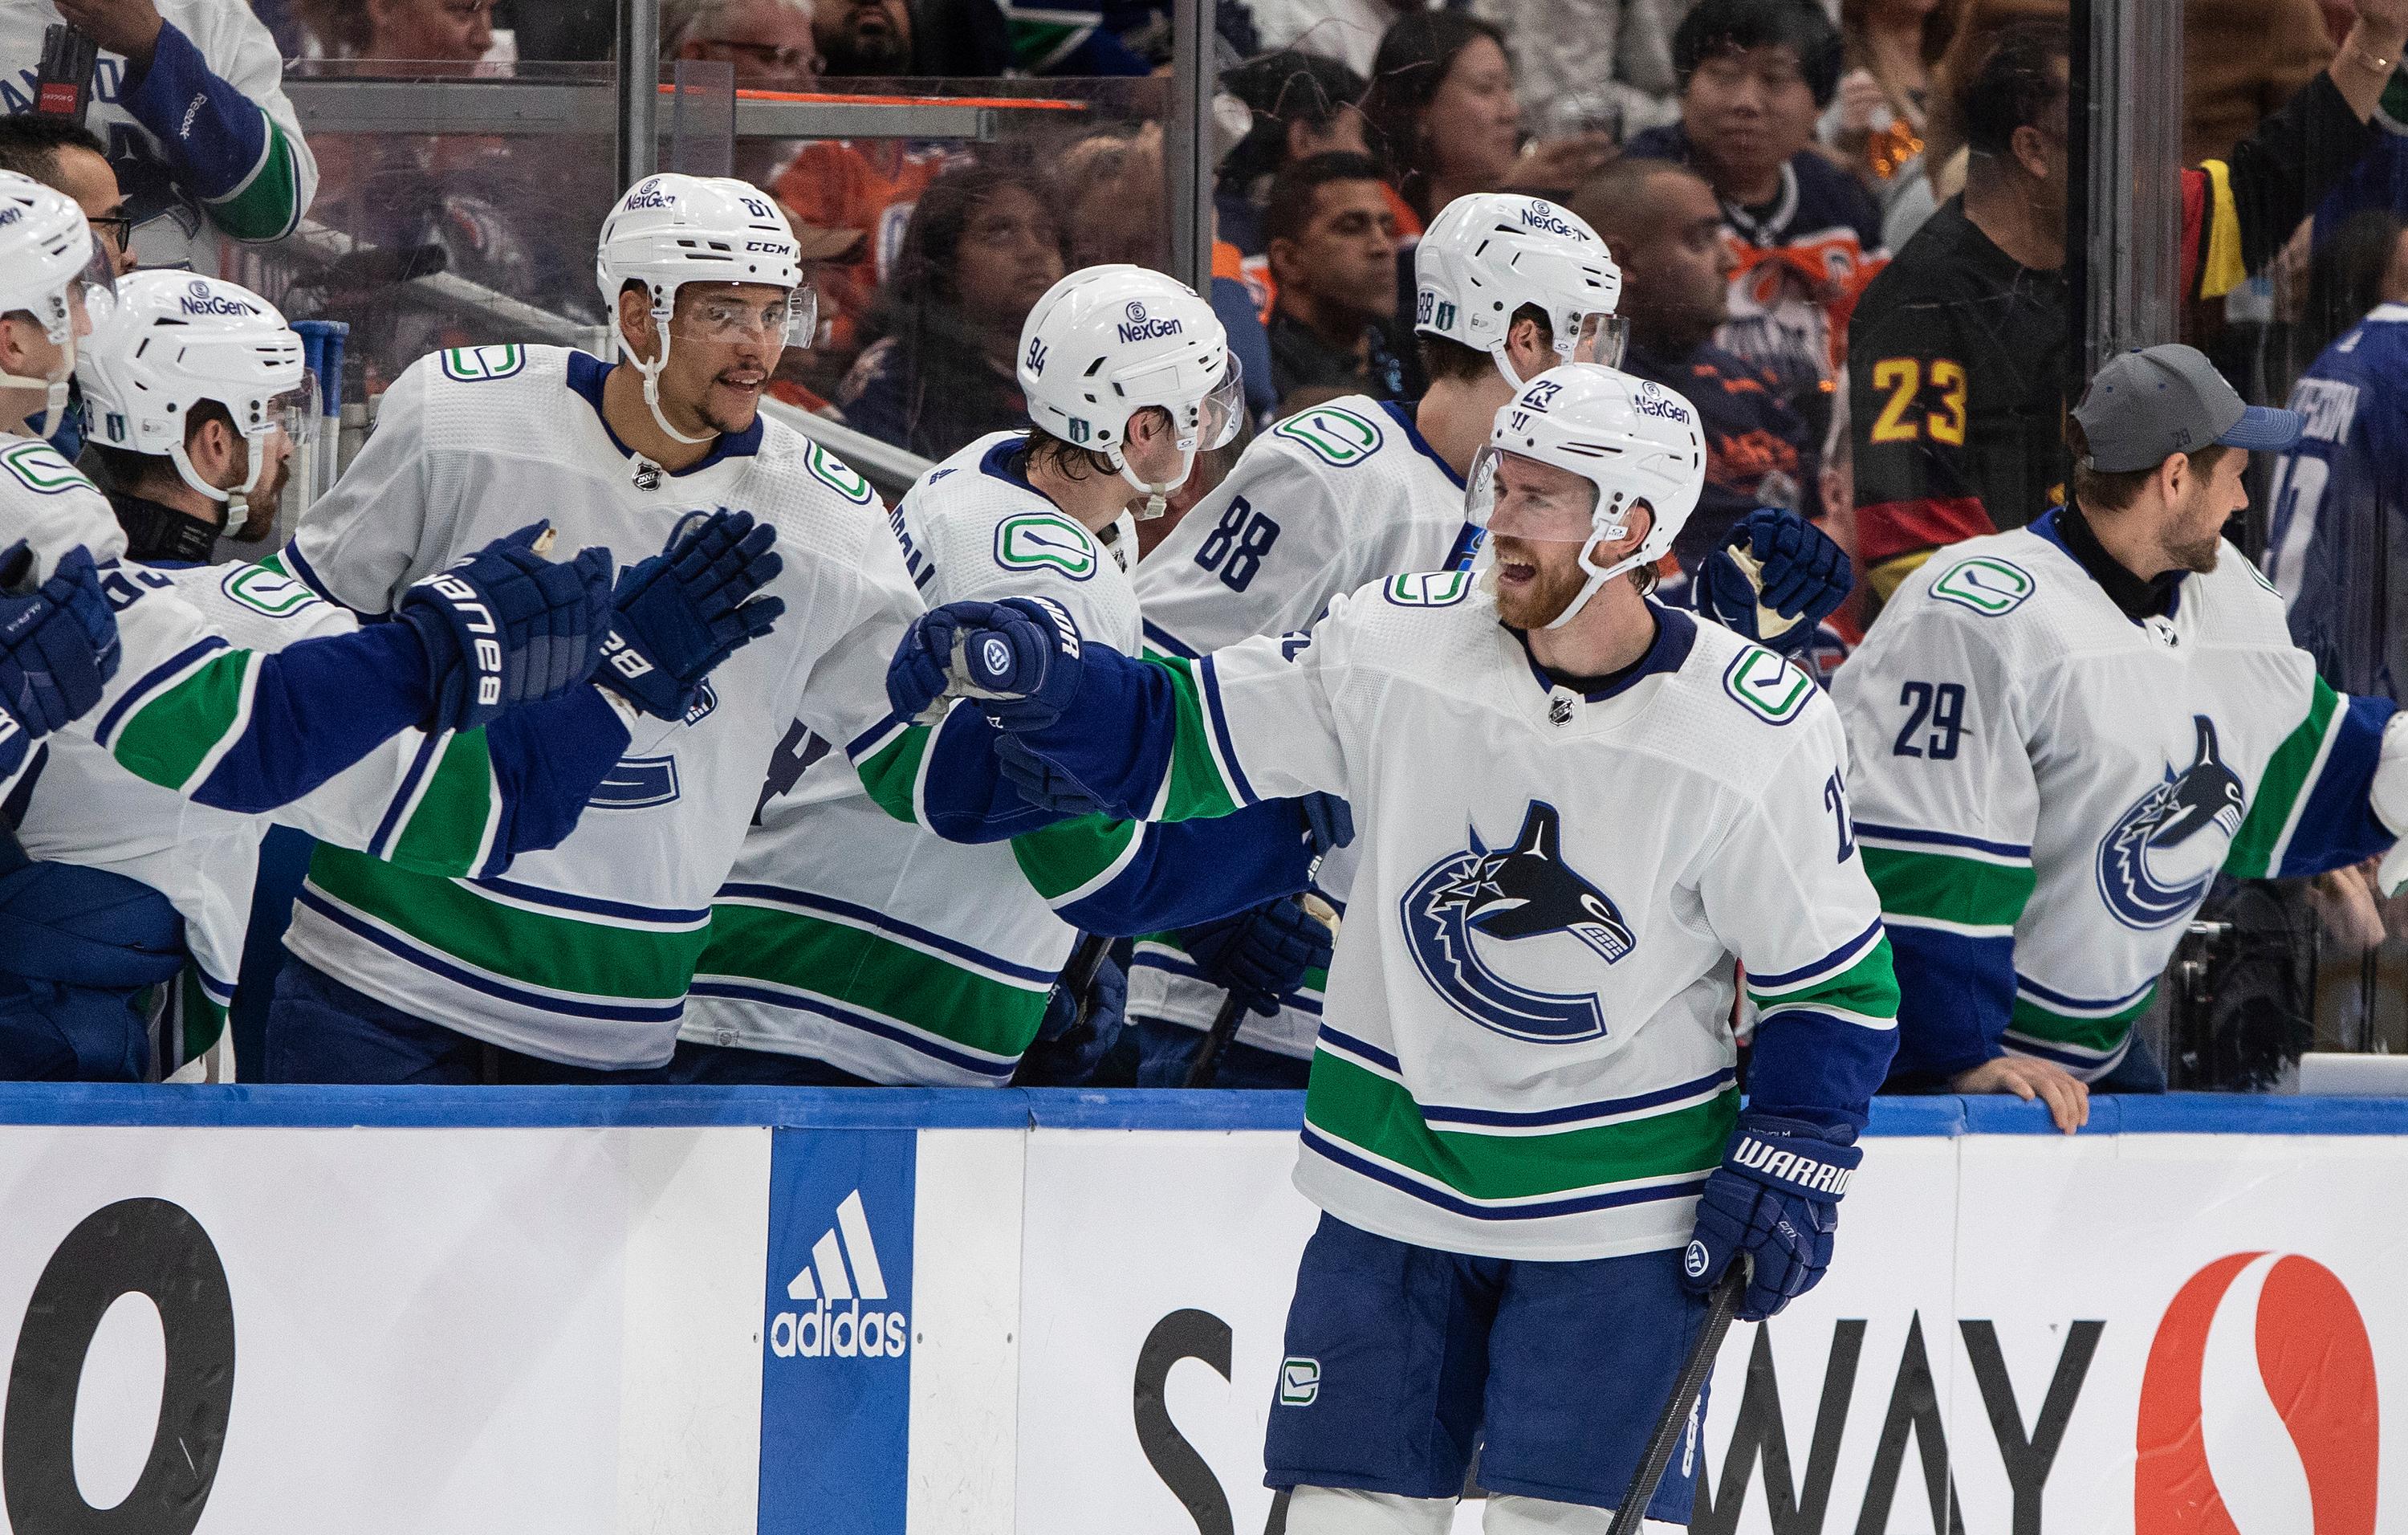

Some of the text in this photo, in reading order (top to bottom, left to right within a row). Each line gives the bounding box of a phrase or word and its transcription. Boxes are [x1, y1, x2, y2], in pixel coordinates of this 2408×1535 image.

[179, 92, 208, 140] Reebok
[623, 191, 676, 211] NexGen
[739, 197, 775, 218] 81
[1521, 208, 1585, 242] NexGen
[746, 242, 791, 255] CCM
[179, 296, 248, 316] NexGen
[1417, 292, 1434, 324] 88
[1117, 319, 1182, 344] NexGen
[1026, 336, 1047, 377] 94
[1523, 380, 1563, 408] 23
[1634, 394, 1690, 425] NexGen
[1871, 357, 1966, 446] 23
[1194, 495, 1280, 592] 88
[1893, 681, 1967, 760] 29
[770, 1299, 905, 1358] adidas
